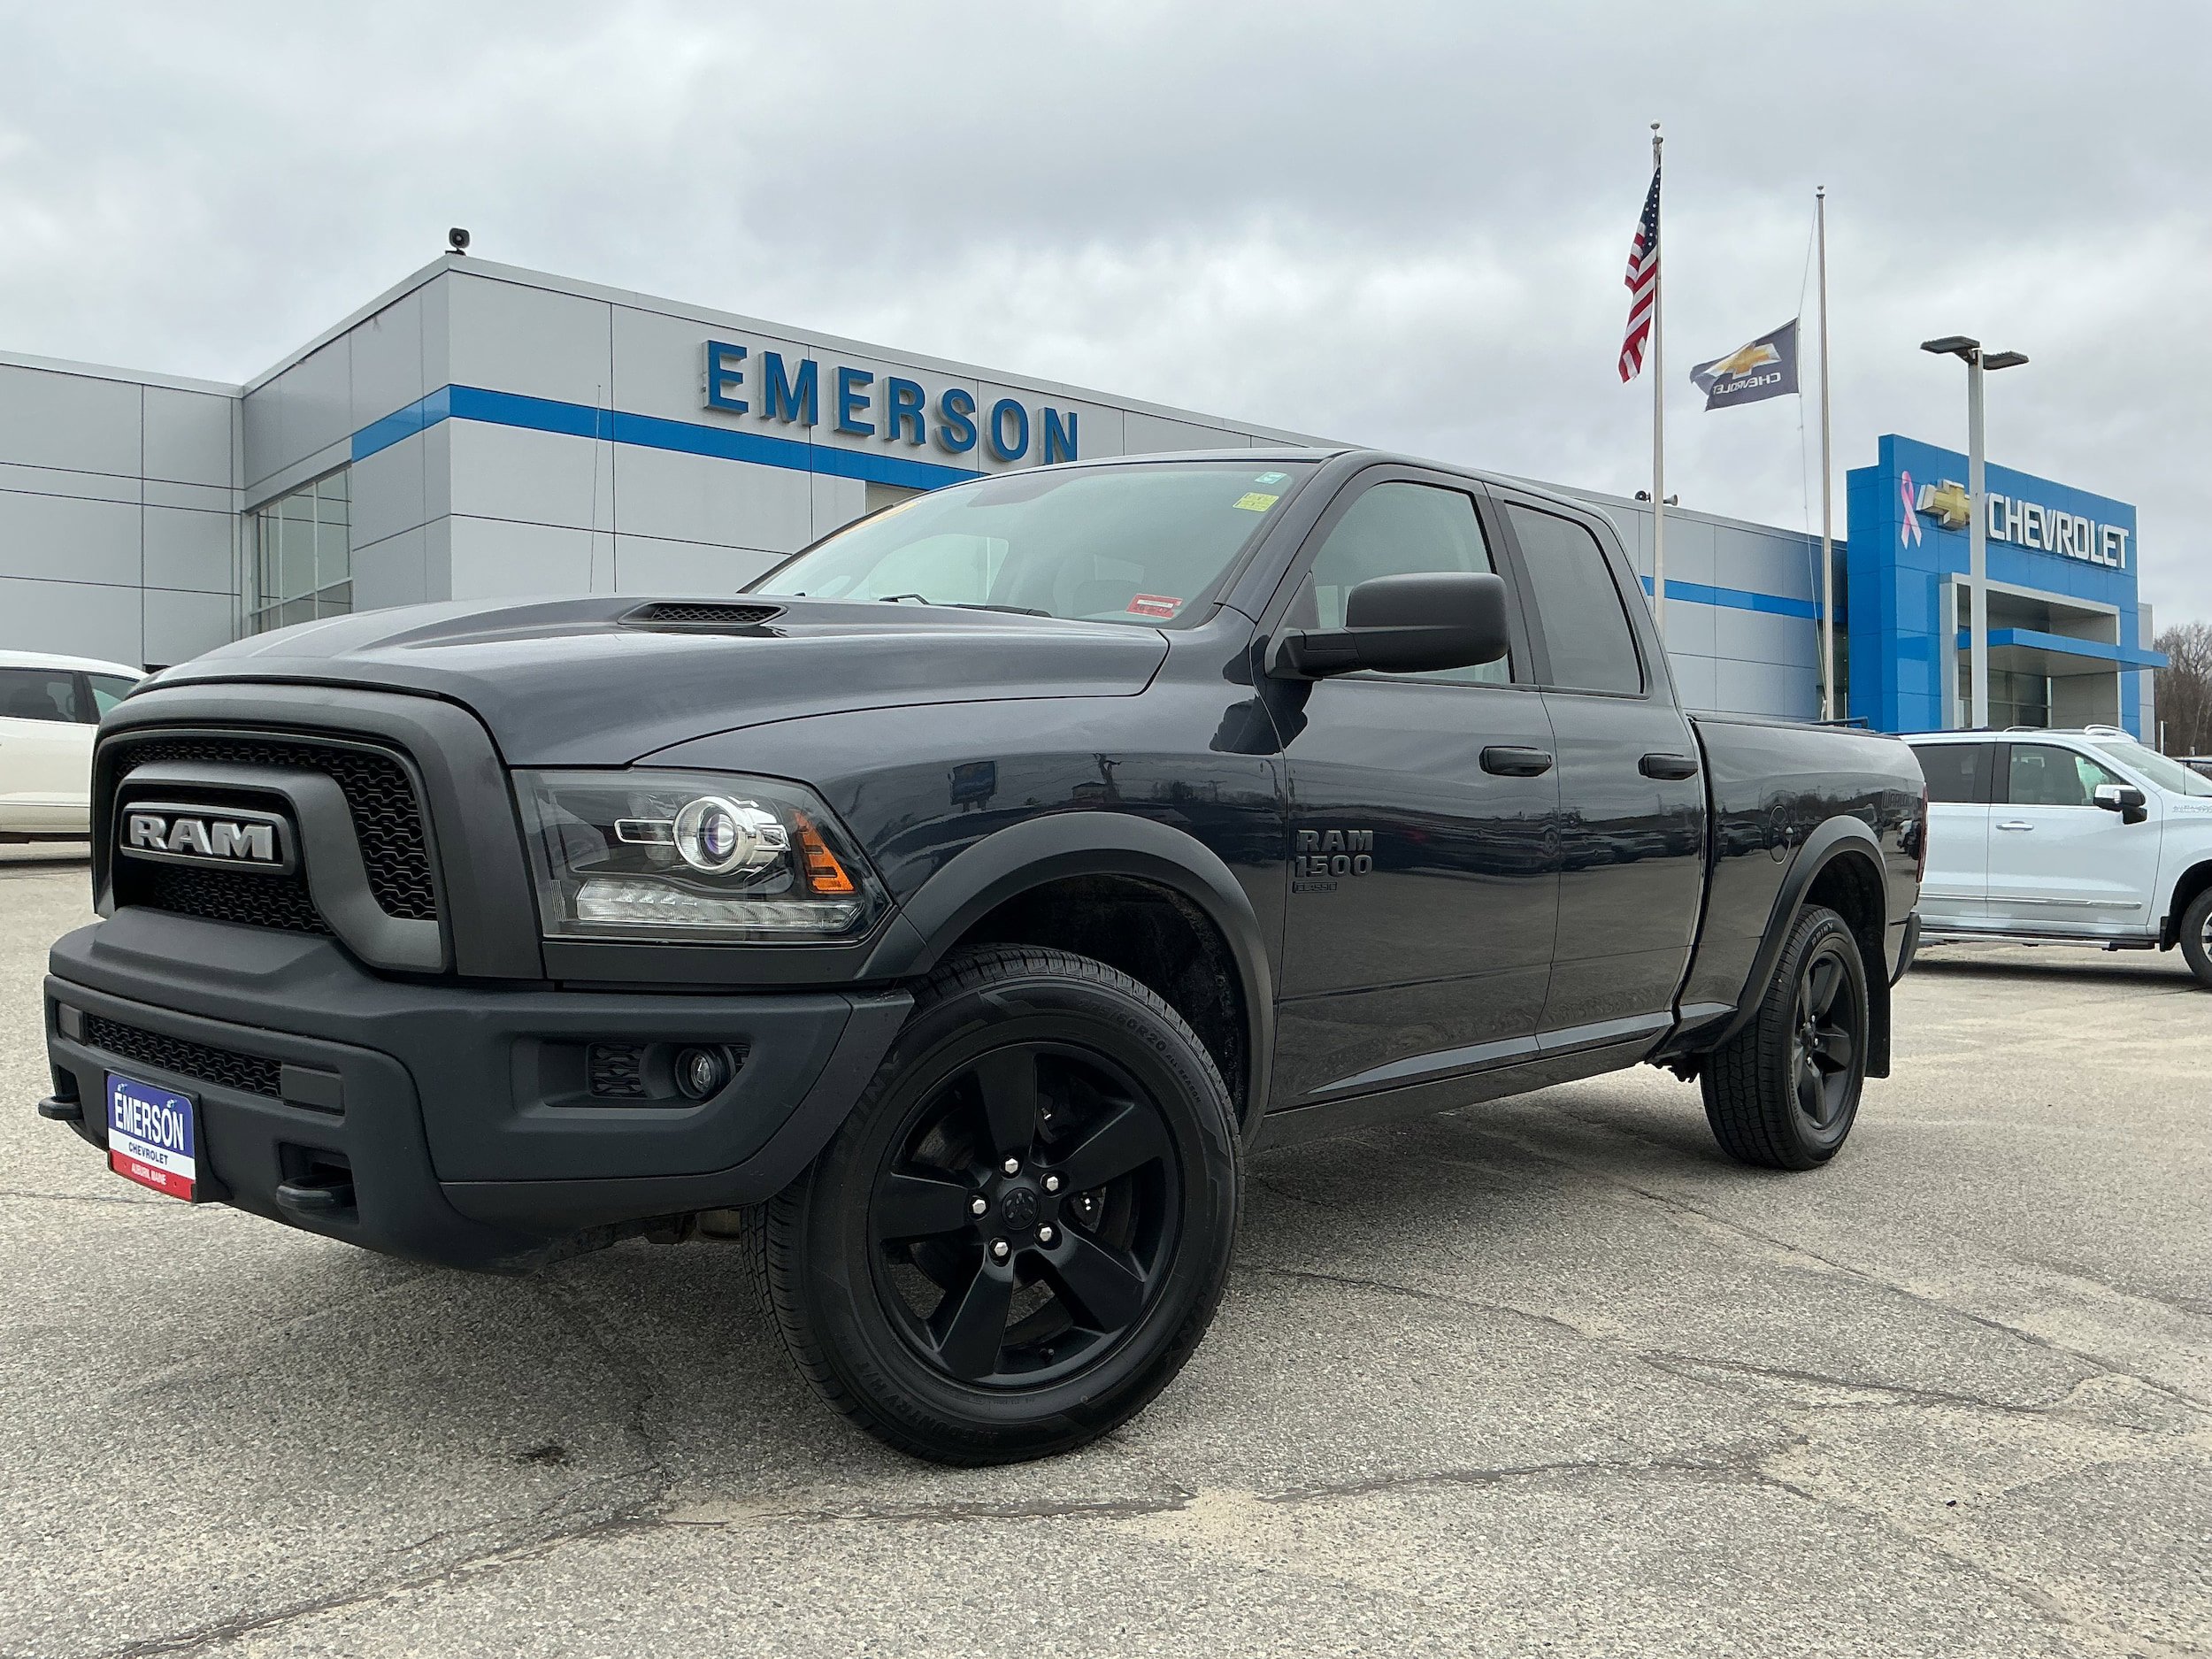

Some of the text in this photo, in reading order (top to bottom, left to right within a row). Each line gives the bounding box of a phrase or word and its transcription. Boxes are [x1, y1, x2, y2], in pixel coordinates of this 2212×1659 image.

[703, 340, 1079, 465] EMERSON
[1987, 492, 2130, 569] CHEVROLET
[130, 814, 273, 861] RAM
[1296, 829, 1374, 851] RAM
[1295, 854, 1373, 877] 1500
[1295, 882, 1337, 892] CLASSIC
[114, 1091, 184, 1151] EMERSON
[128, 1141, 169, 1165] CHEVROLET
